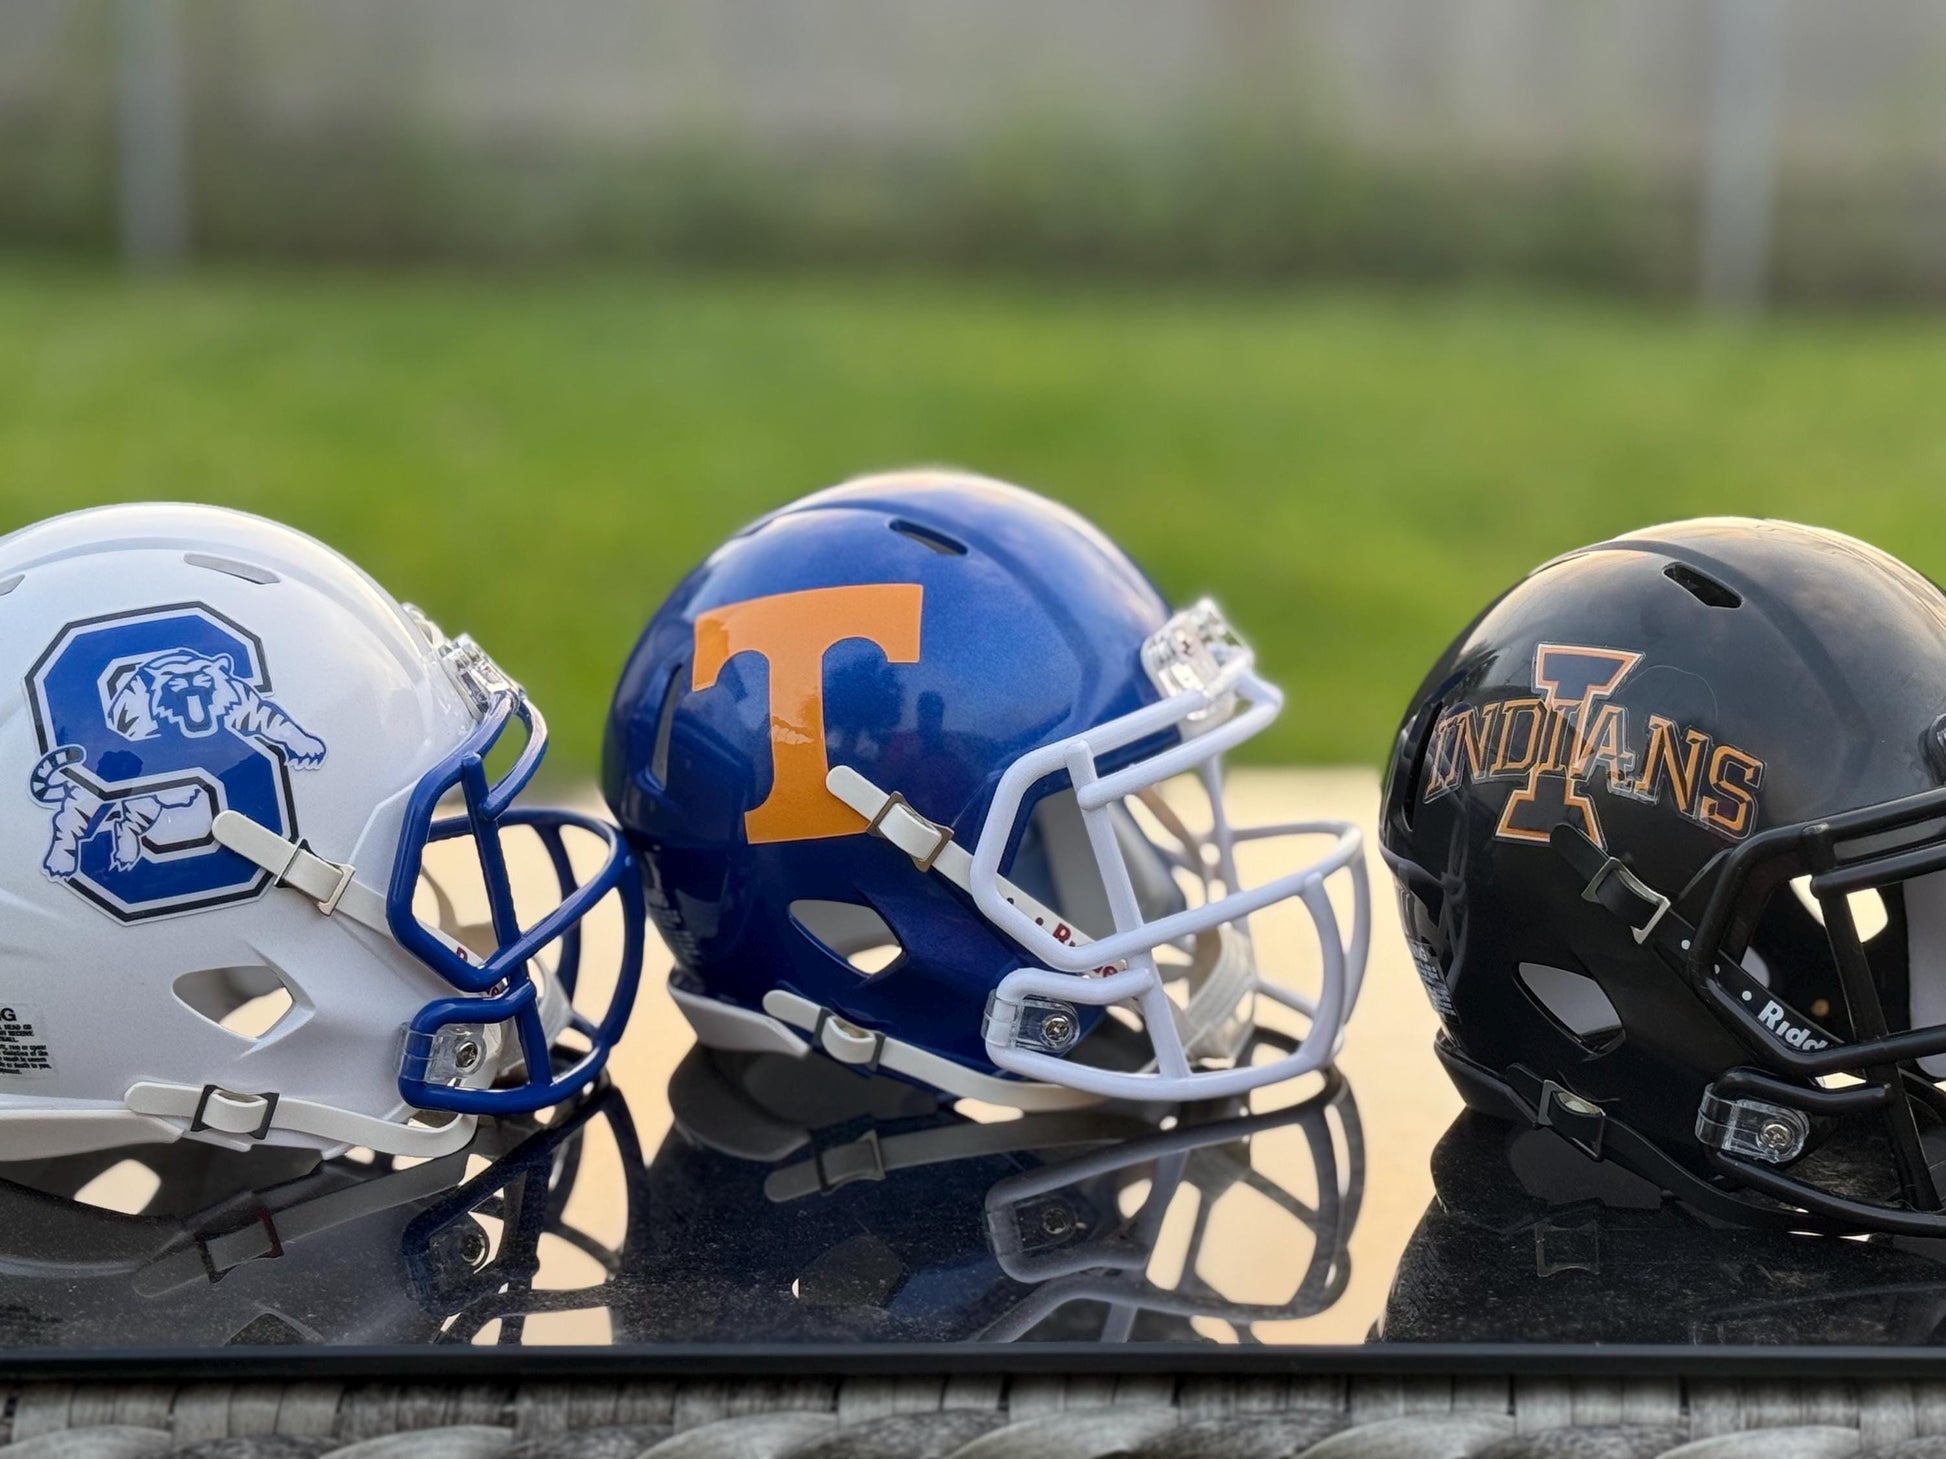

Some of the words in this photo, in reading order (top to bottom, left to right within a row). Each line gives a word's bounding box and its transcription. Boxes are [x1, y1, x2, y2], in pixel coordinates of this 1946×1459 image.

[692, 583, 923, 844] T
[1424, 697, 1767, 840] INDIANS
[0, 1007, 17, 1021] G
[1757, 1000, 1829, 1050] Ridd
